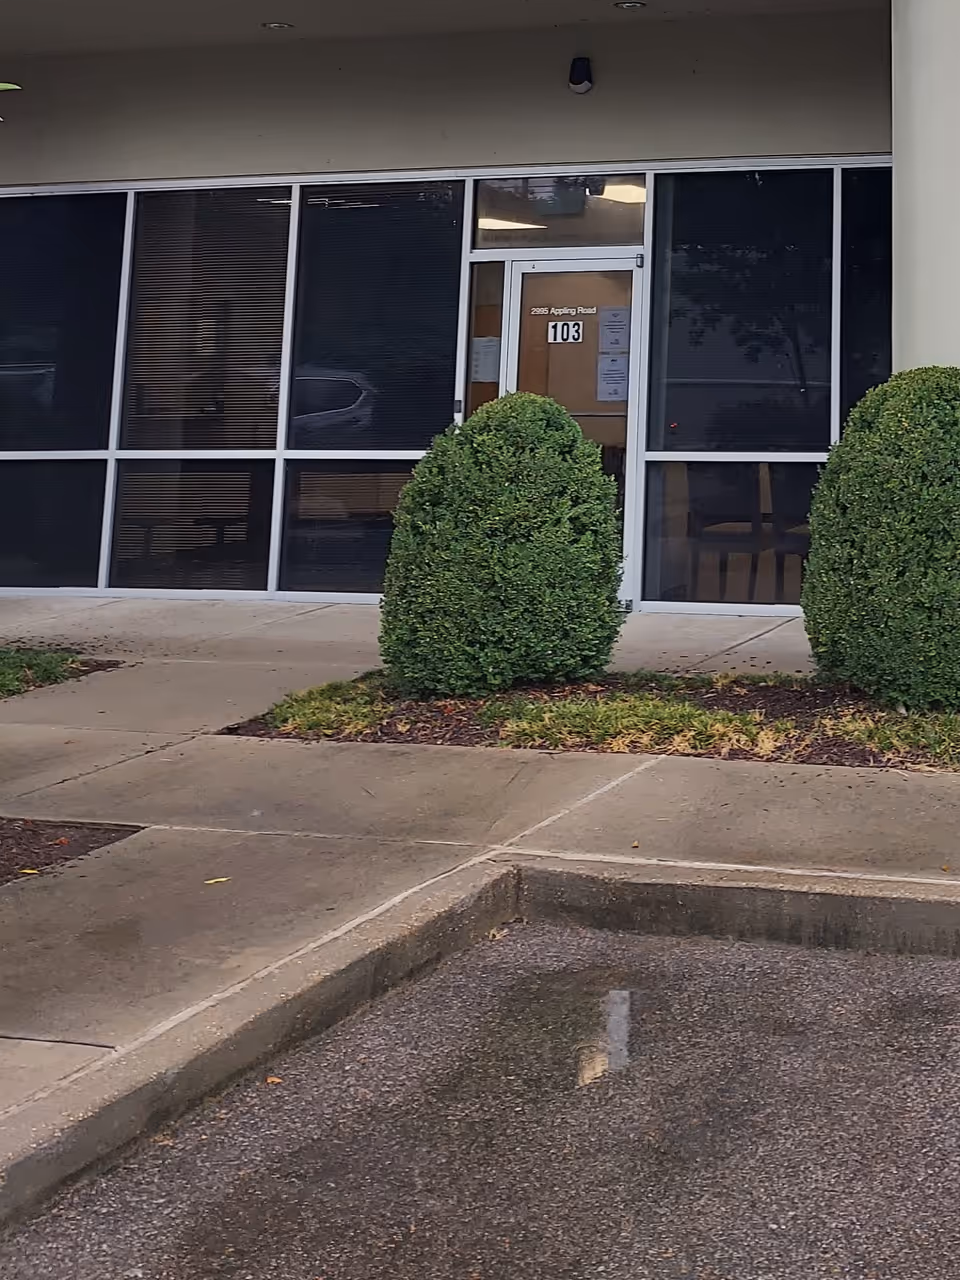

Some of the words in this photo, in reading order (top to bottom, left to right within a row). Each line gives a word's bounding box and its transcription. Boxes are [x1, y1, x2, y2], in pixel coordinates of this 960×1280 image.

[550, 307, 577, 316] Appling
[577, 306, 597, 314] Road
[551, 322, 581, 342] 103
